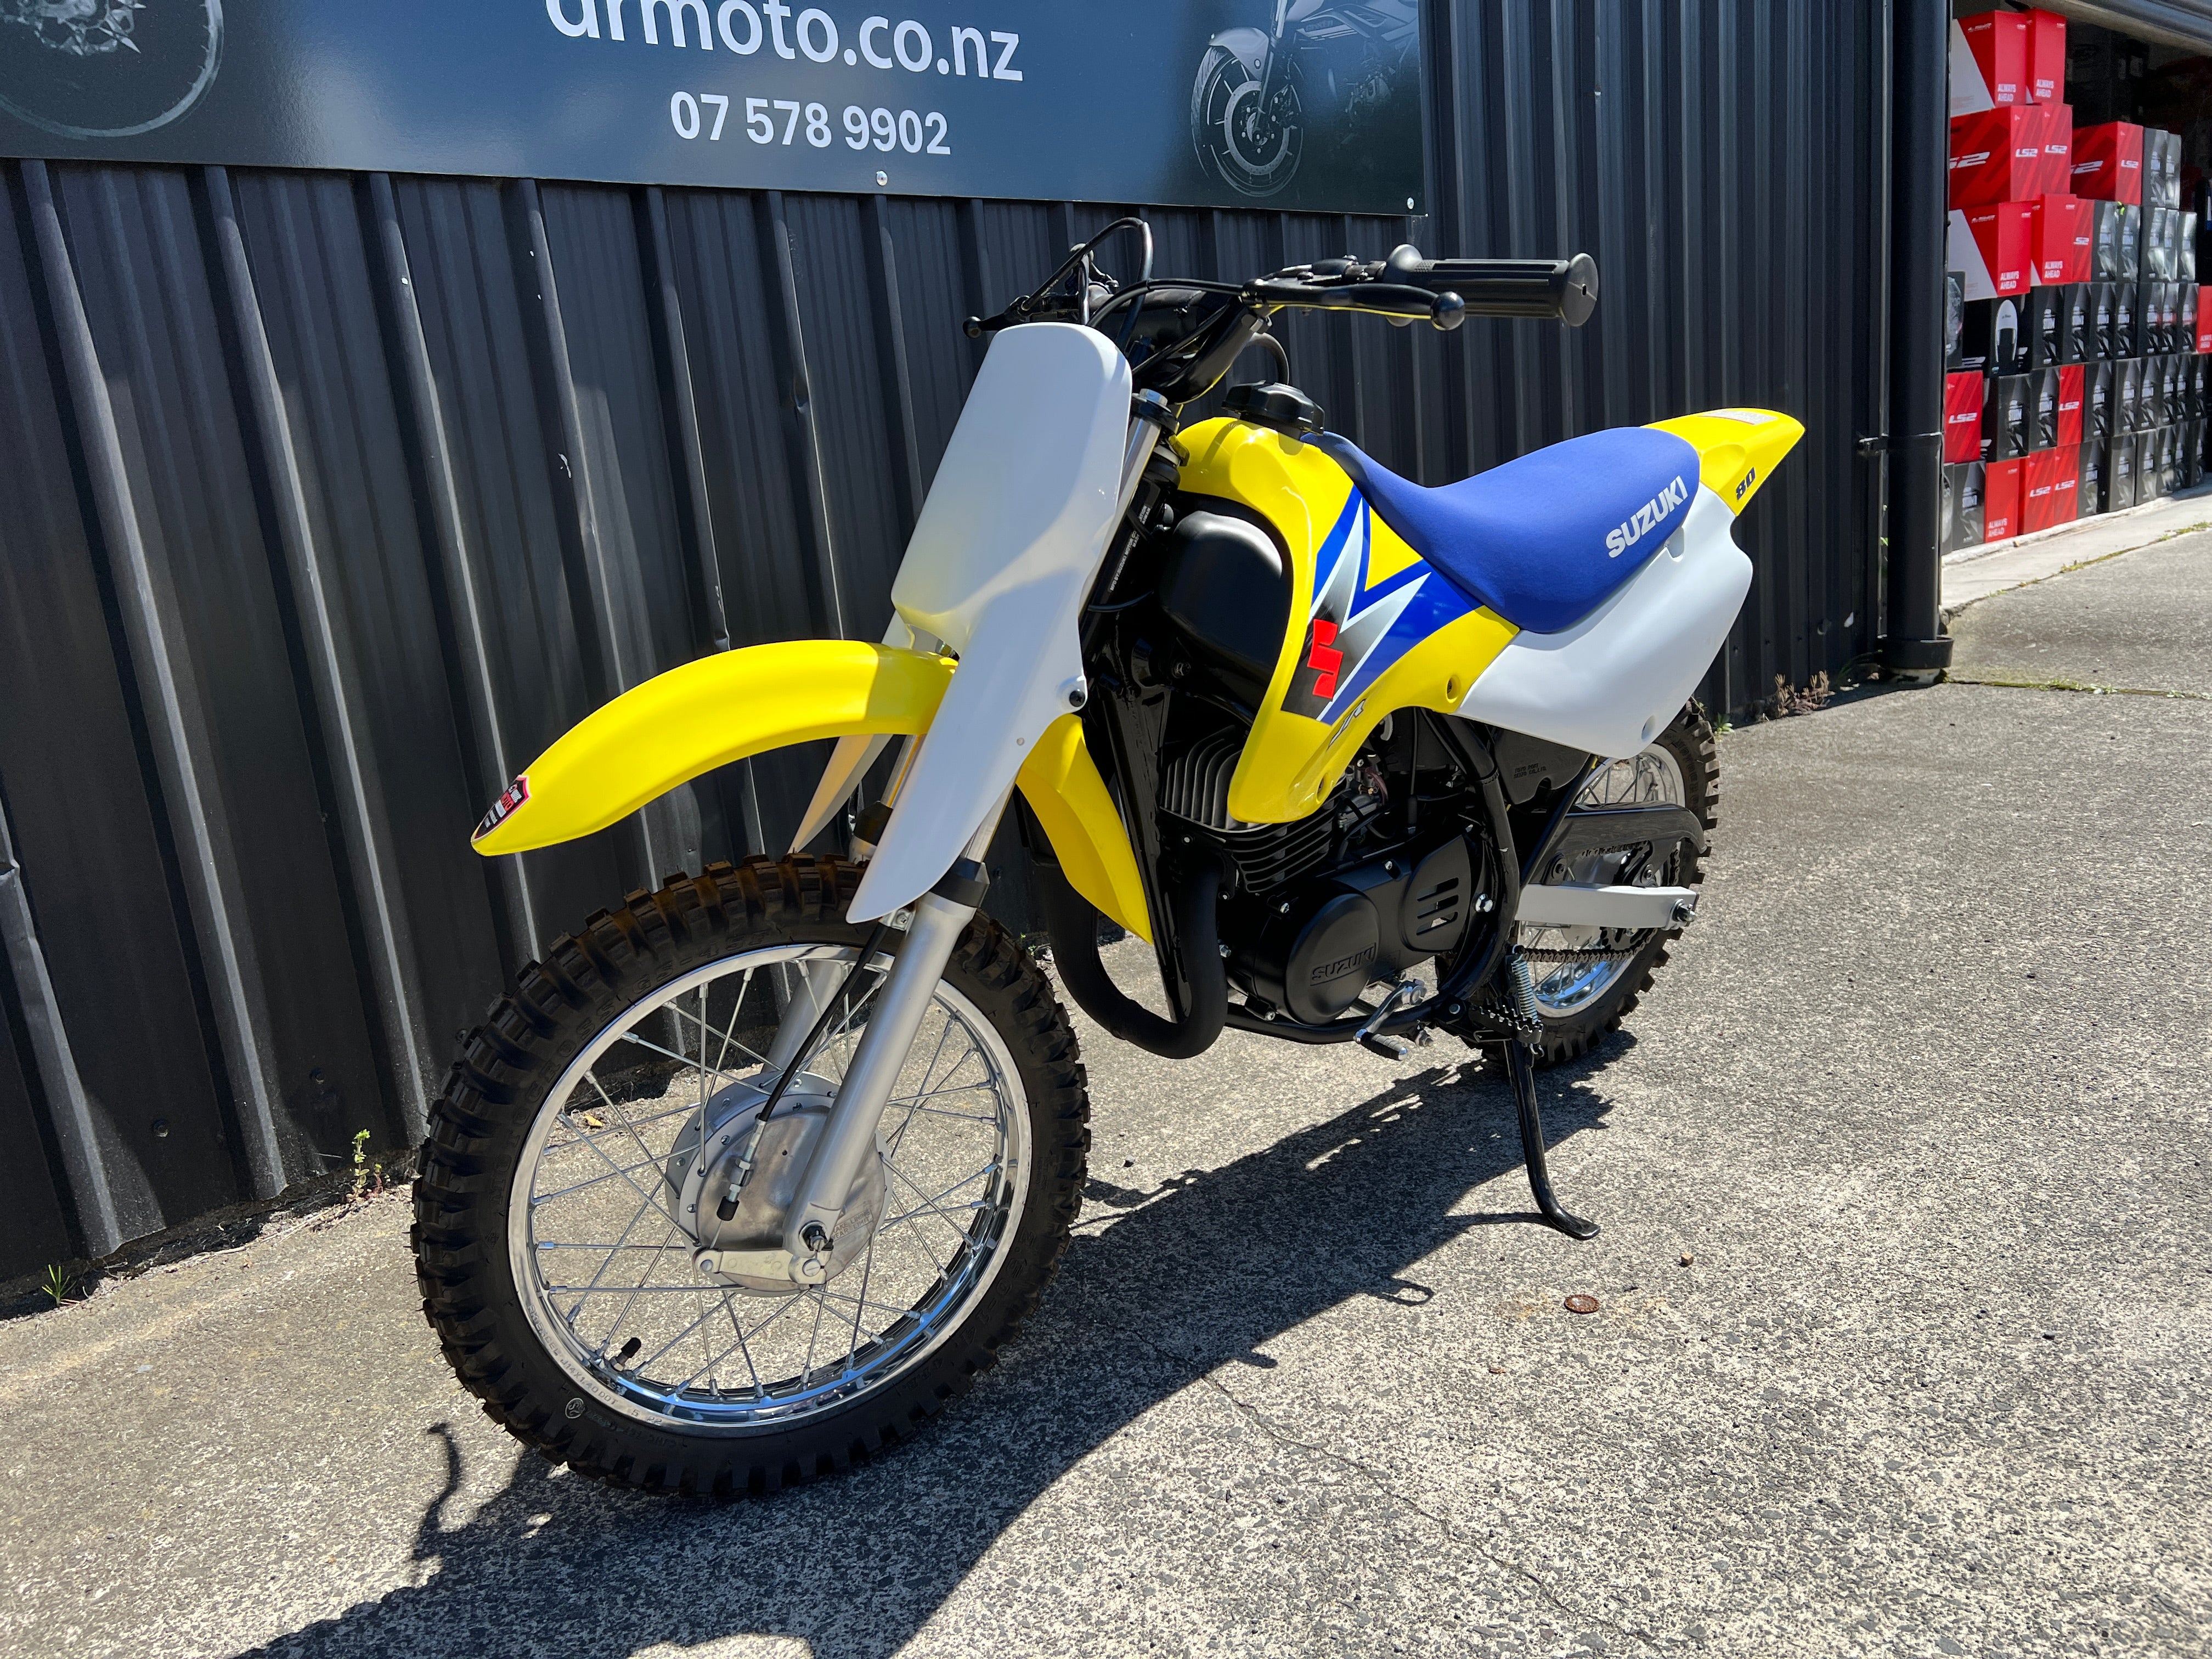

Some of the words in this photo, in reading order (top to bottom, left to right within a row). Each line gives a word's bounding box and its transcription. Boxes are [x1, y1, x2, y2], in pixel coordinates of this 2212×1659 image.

[670, 91, 729, 140] 07
[746, 97, 832, 148] 578
[843, 105, 951, 155] 9902
[2015, 148, 2038, 157] LS2
[2045, 144, 2068, 154] LS2
[2120, 160, 2139, 168] LS2
[2045, 261, 2063, 269] ALWAYS
[2000, 271, 2019, 281] ALWAYS
[2045, 269, 2060, 278] AHEAD
[2000, 280, 2017, 290] AHEAD
[2058, 401, 2080, 411] LS2
[1948, 412, 1977, 424] LS2
[1735, 466, 1756, 501] 80
[2055, 479, 2075, 491] LS2
[2029, 486, 2052, 498] LS2
[1605, 475, 1689, 558] SUZUKI
[1311, 945, 1376, 981] SUZUKI
[599, 1391, 618, 1406] DOT
[631, 1408, 640, 1418] 5
[646, 1415, 663, 1426] 22
